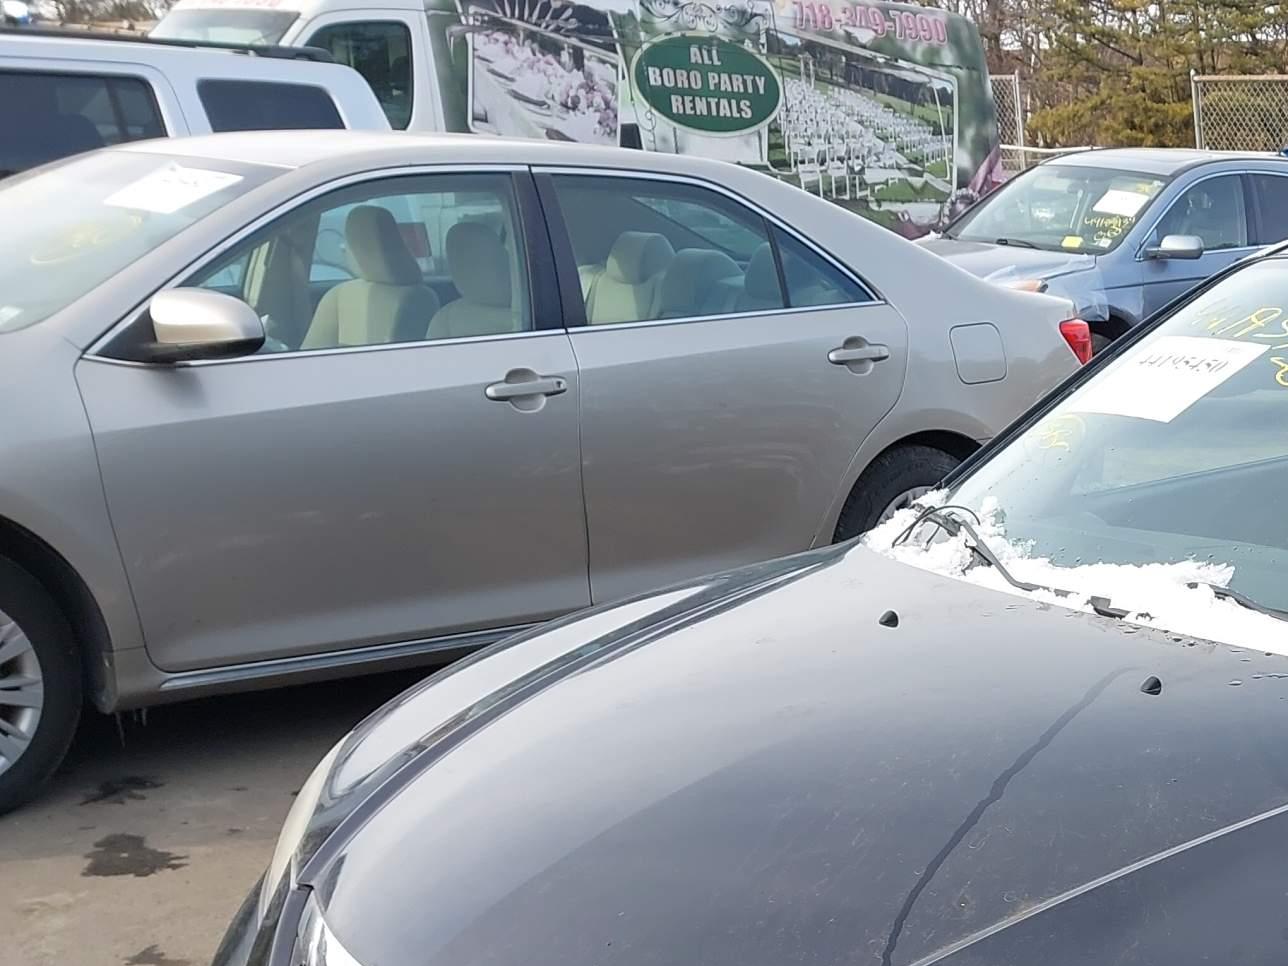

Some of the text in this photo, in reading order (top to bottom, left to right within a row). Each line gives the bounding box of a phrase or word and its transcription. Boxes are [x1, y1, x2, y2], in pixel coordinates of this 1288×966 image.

[690, 44, 721, 65] ALL
[648, 66, 765, 94] BORO PARTY
[671, 94, 752, 118] RENTALS
